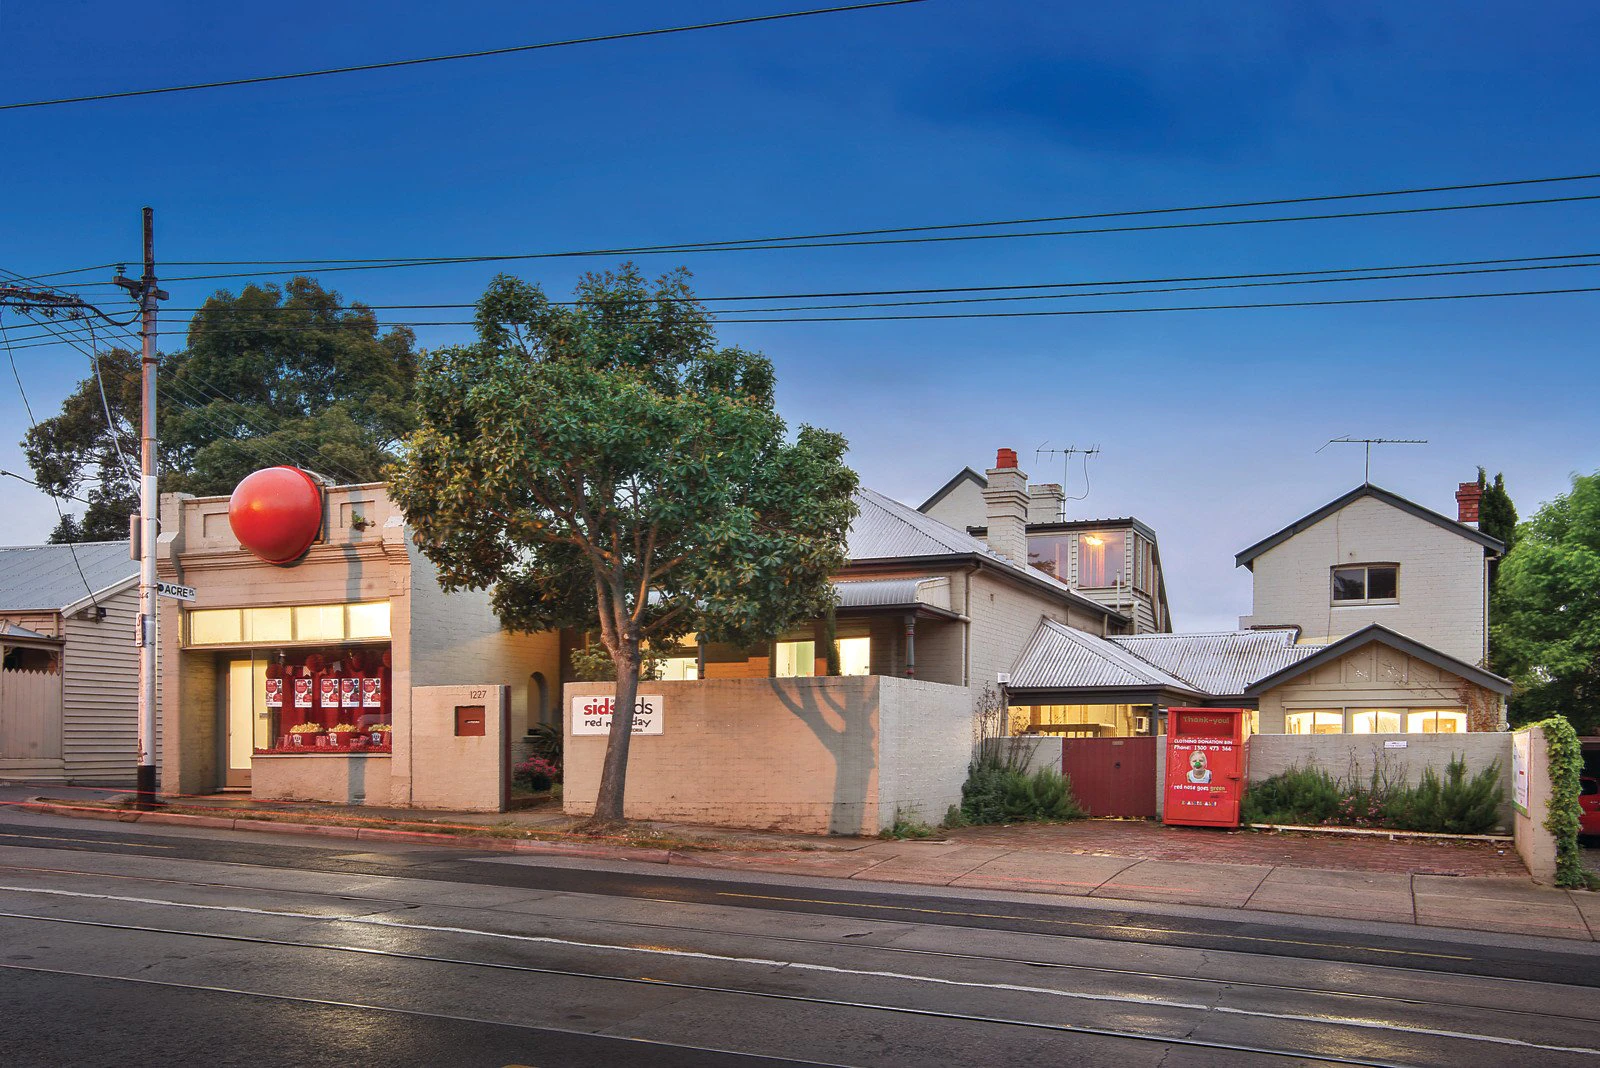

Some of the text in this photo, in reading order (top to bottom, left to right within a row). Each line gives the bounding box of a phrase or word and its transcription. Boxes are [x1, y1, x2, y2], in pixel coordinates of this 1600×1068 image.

[164, 584, 188, 597] ACRE
[470, 690, 487, 699] 1227
[584, 718, 602, 727] red
[1183, 716, 1230, 724] Thank-you!
